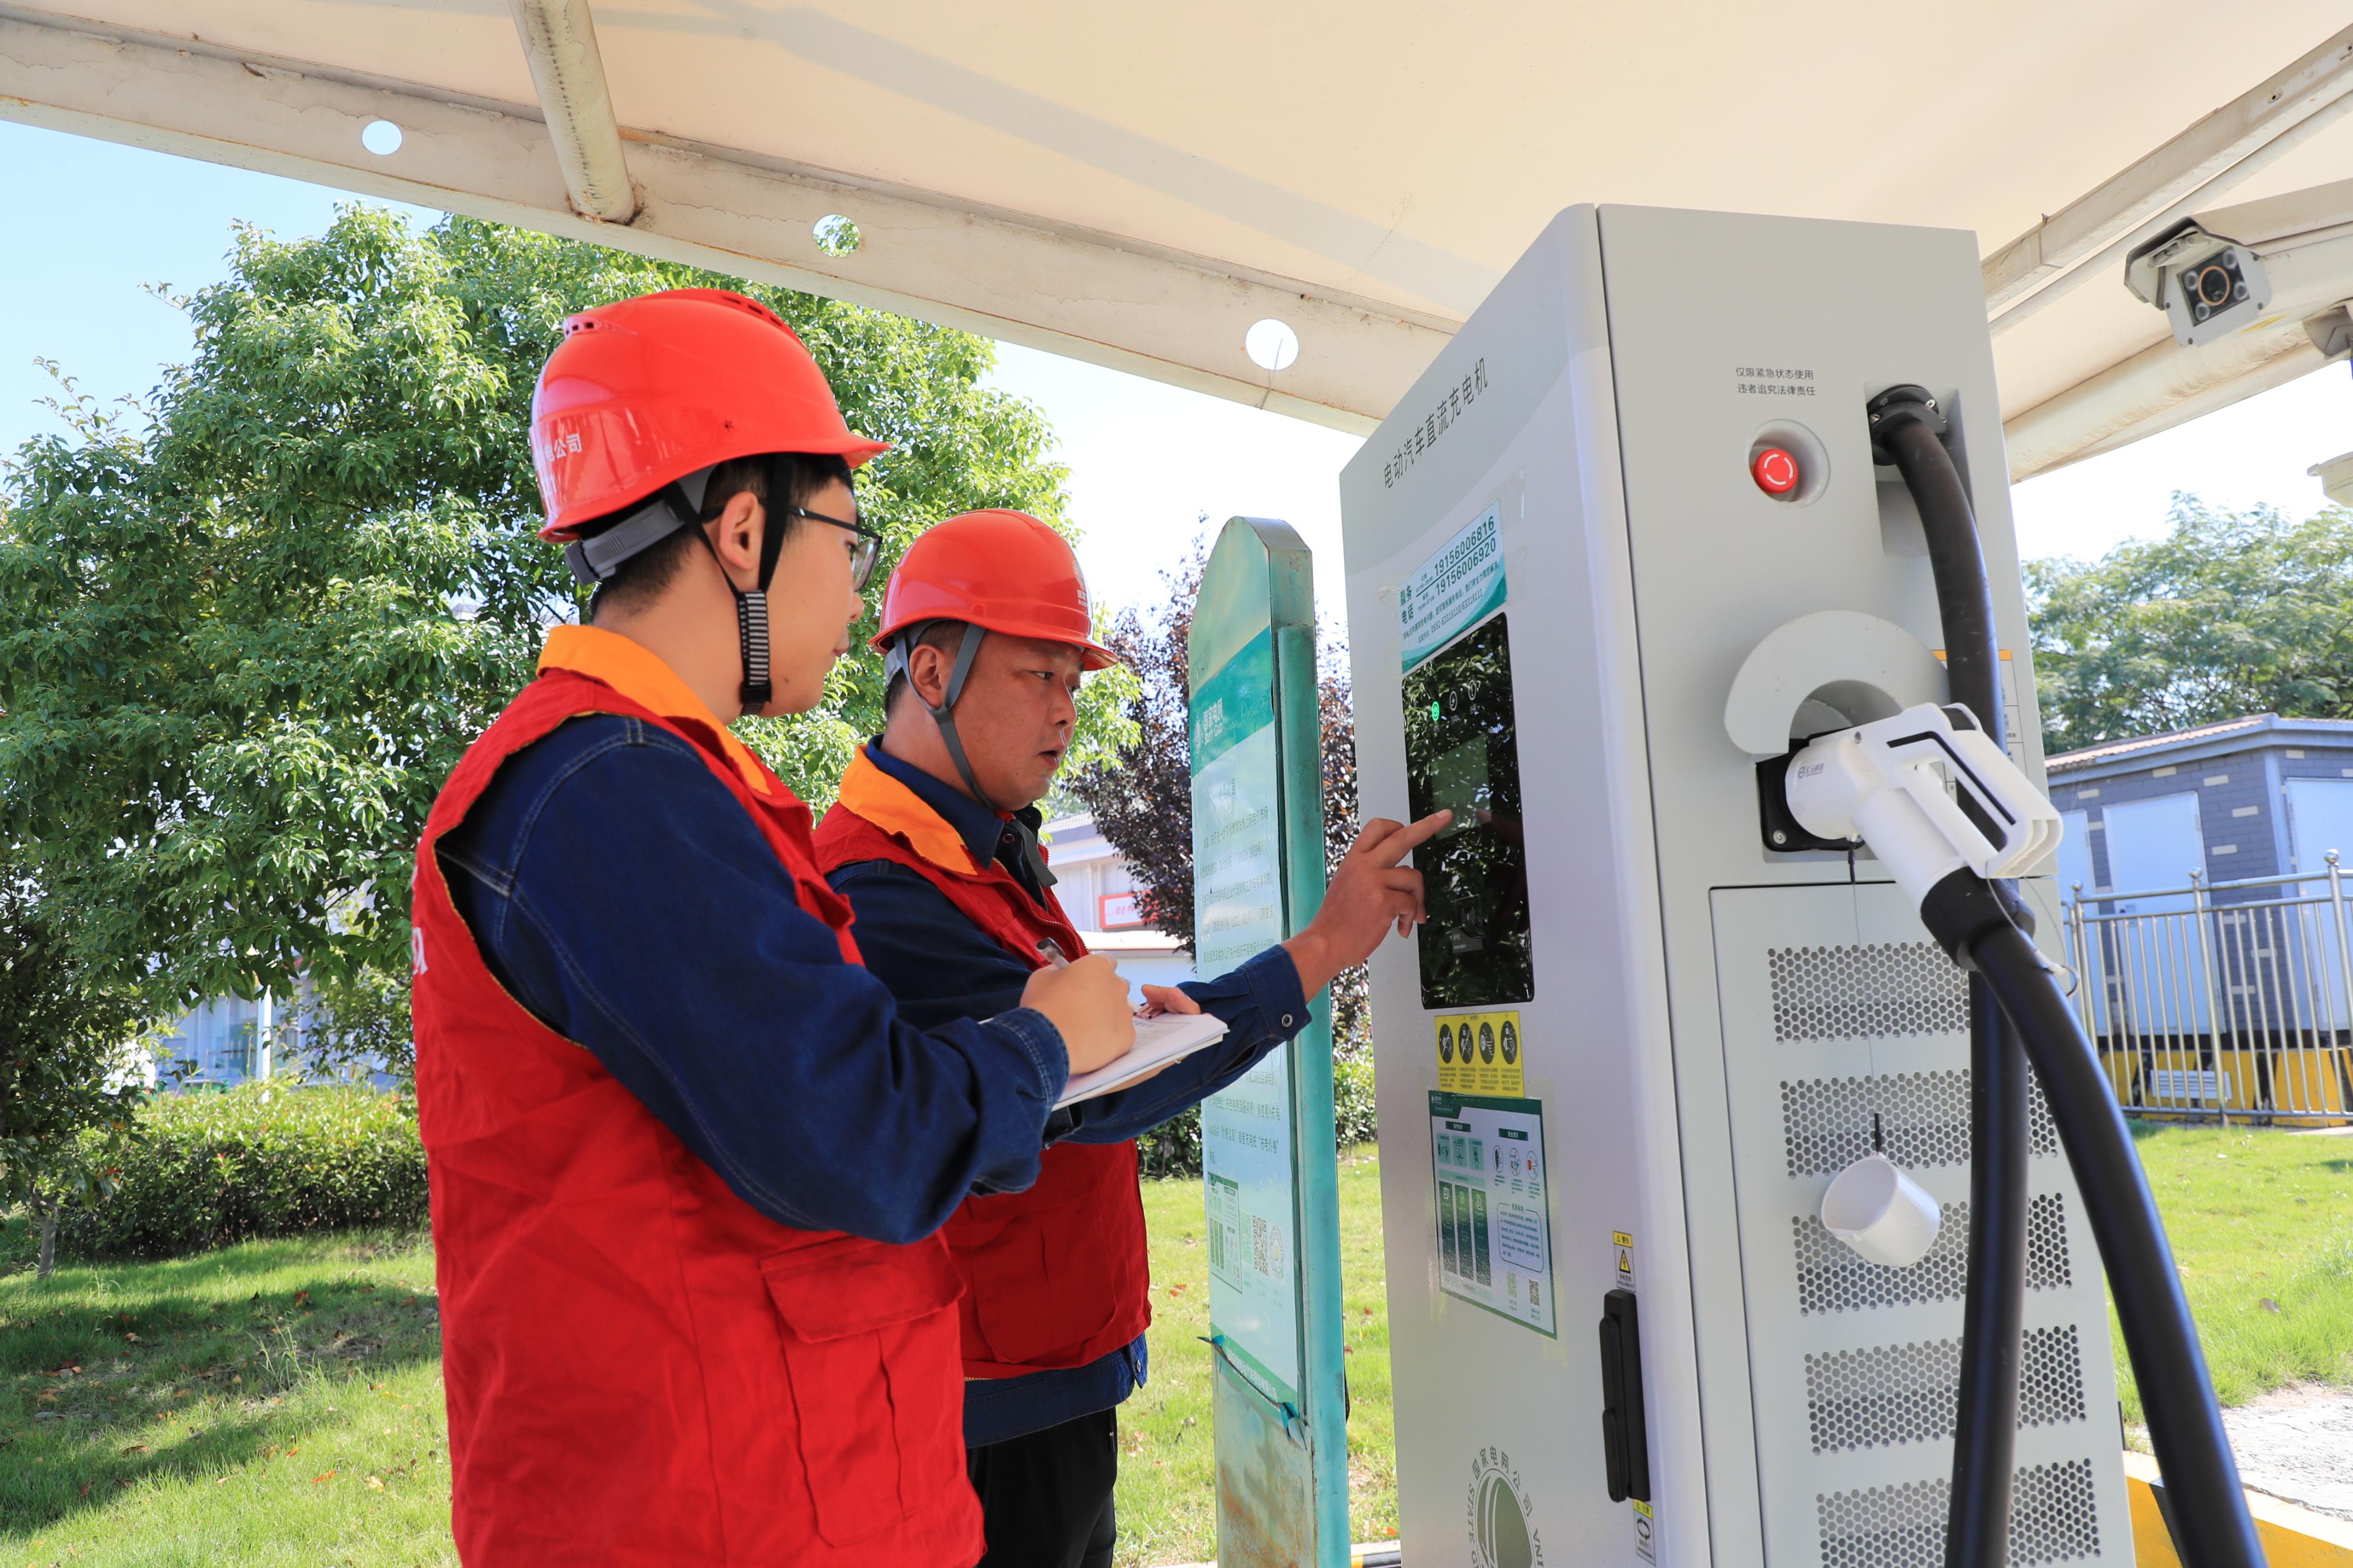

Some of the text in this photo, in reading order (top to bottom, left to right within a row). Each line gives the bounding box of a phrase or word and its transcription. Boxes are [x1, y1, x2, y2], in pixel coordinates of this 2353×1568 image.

[1736, 367, 1814, 380] 仅限紧急状态使用
[1738, 384, 1816, 396] 违者追究法律责任
[1384, 357, 1488, 489] 电动汽车直流充电机
[1434, 516, 1494, 576] 19156006816
[1436, 537, 1496, 596] 19156006920
[1402, 603, 1414, 625] 电话
[1472, 1445, 1532, 1517] 国家电网公司
